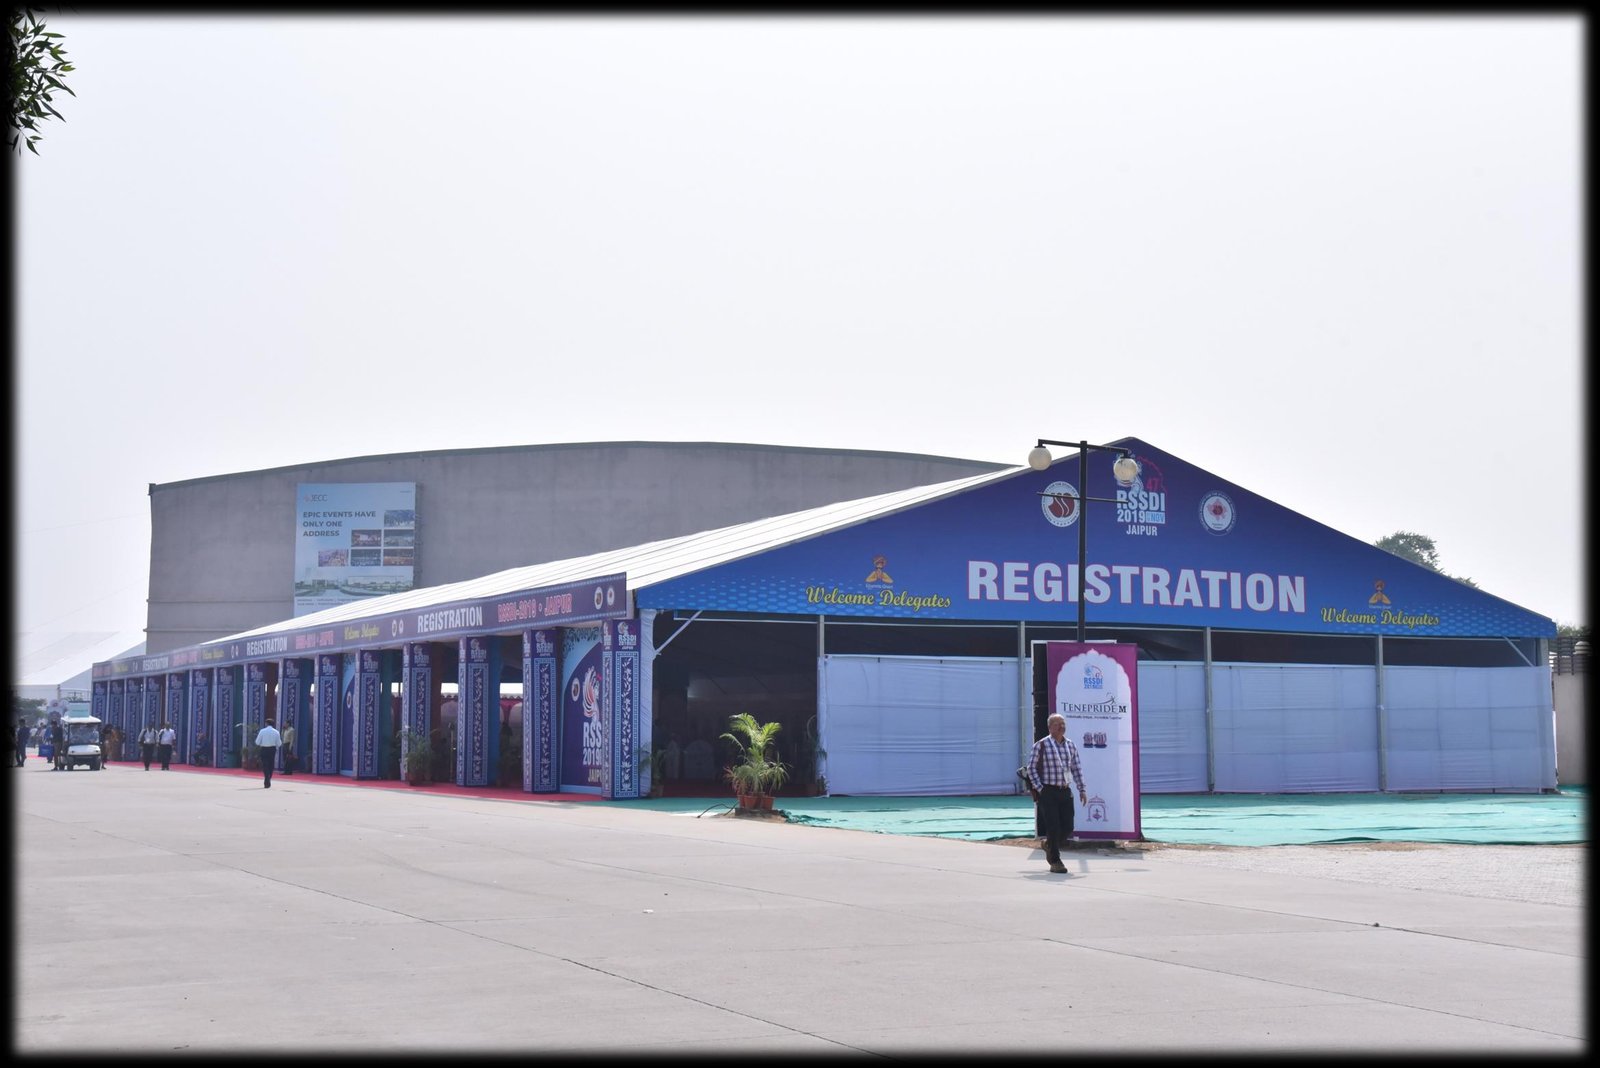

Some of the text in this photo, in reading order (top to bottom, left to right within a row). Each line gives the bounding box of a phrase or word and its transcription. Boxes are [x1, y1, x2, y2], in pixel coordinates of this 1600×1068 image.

[1116, 490, 1165, 512] RSSDI
[1117, 509, 1146, 524] 2019
[1126, 525, 1158, 536] JAIPUR
[968, 560, 1306, 613] REGISTRATION
[806, 586, 951, 611] Welcome Delegates
[417, 606, 483, 633] REGISTRATION
[1321, 607, 1439, 629] Welcome Delegates
[246, 636, 288, 656] REGISTRATION
[1061, 701, 1117, 714] TENEPRIDE
[583, 721, 602, 748] RSS
